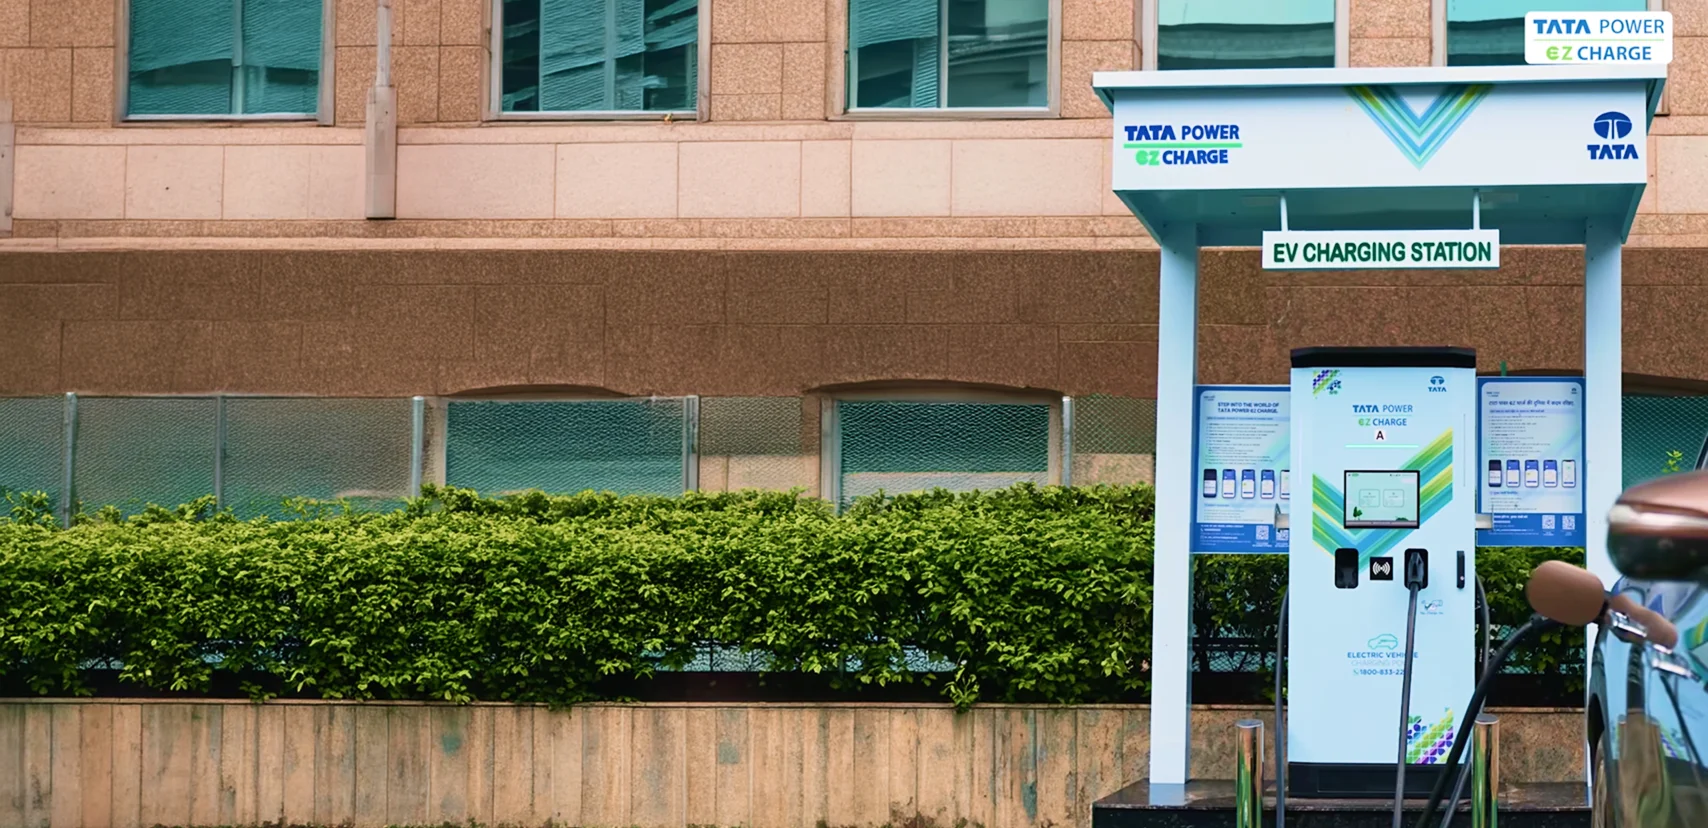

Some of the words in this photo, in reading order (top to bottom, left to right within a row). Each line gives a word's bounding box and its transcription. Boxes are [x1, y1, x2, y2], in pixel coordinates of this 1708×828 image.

[1124, 125, 1177, 141] TATA
[1181, 125, 1240, 140] POWER
[1162, 150, 1229, 165] CHARGE
[1587, 144, 1639, 160] TATA
[1273, 242, 1298, 262] EV
[1302, 242, 1406, 262] CHARGING
[1411, 241, 1492, 261] STATION
[1352, 405, 1379, 413] TATA
[1382, 404, 1413, 413] POWER
[1372, 418, 1408, 426] CHARGE
[1376, 431, 1384, 440] A
[1347, 651, 1384, 659] ELECTRIC
[1385, 651, 1418, 659] VEHIE
